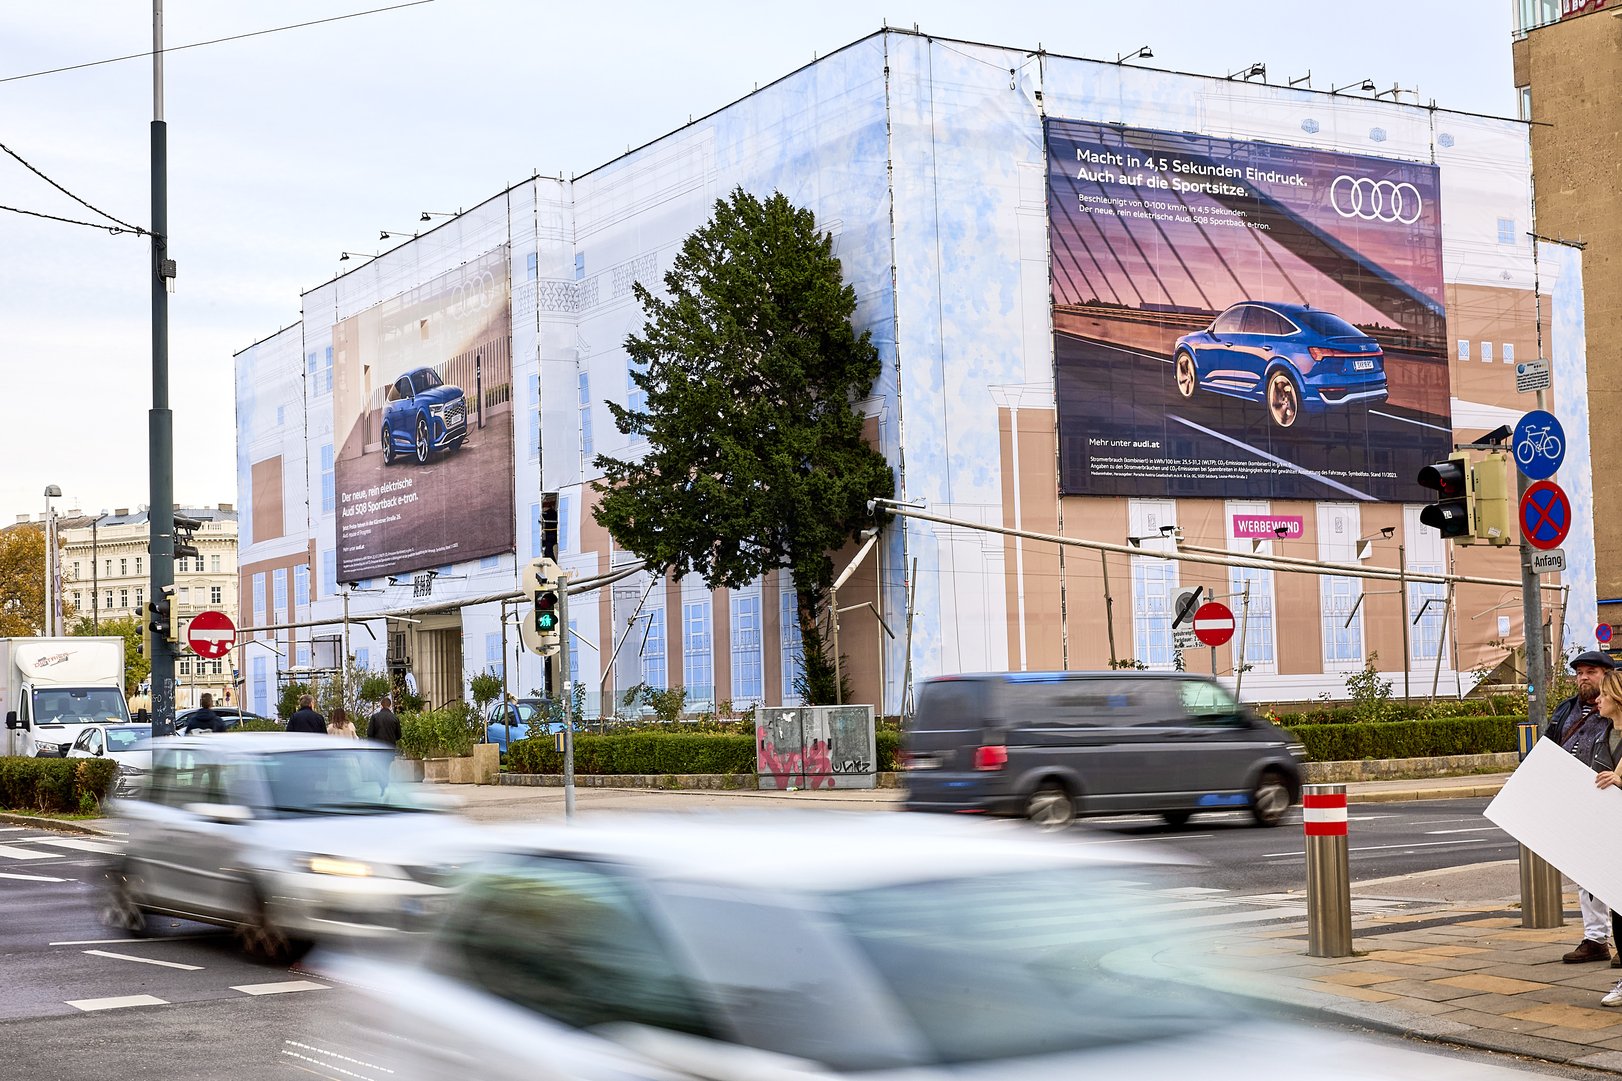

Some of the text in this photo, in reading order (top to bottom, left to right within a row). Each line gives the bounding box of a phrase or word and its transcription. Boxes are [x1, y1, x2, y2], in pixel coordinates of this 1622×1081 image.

[1076, 149, 1308, 187] Macht in 4,5 Sekunden Eindruck.
[1077, 167, 1249, 197] Auch auf die Sportsitze.
[1078, 193, 1248, 218] Beschleunigt von 0-100 km/h in 4,5 Sekunden.
[1079, 204, 1271, 230] Der neue, rein elektrische Audi SQ8 Sportback e-tron.
[1089, 438, 1160, 449] Mehr unter audi.at
[341, 477, 413, 503] Der neue, rein elektrische
[341, 492, 419, 518] Audi SQ8 Sportback e-tron.
[1534, 554, 1562, 568] Anfang
